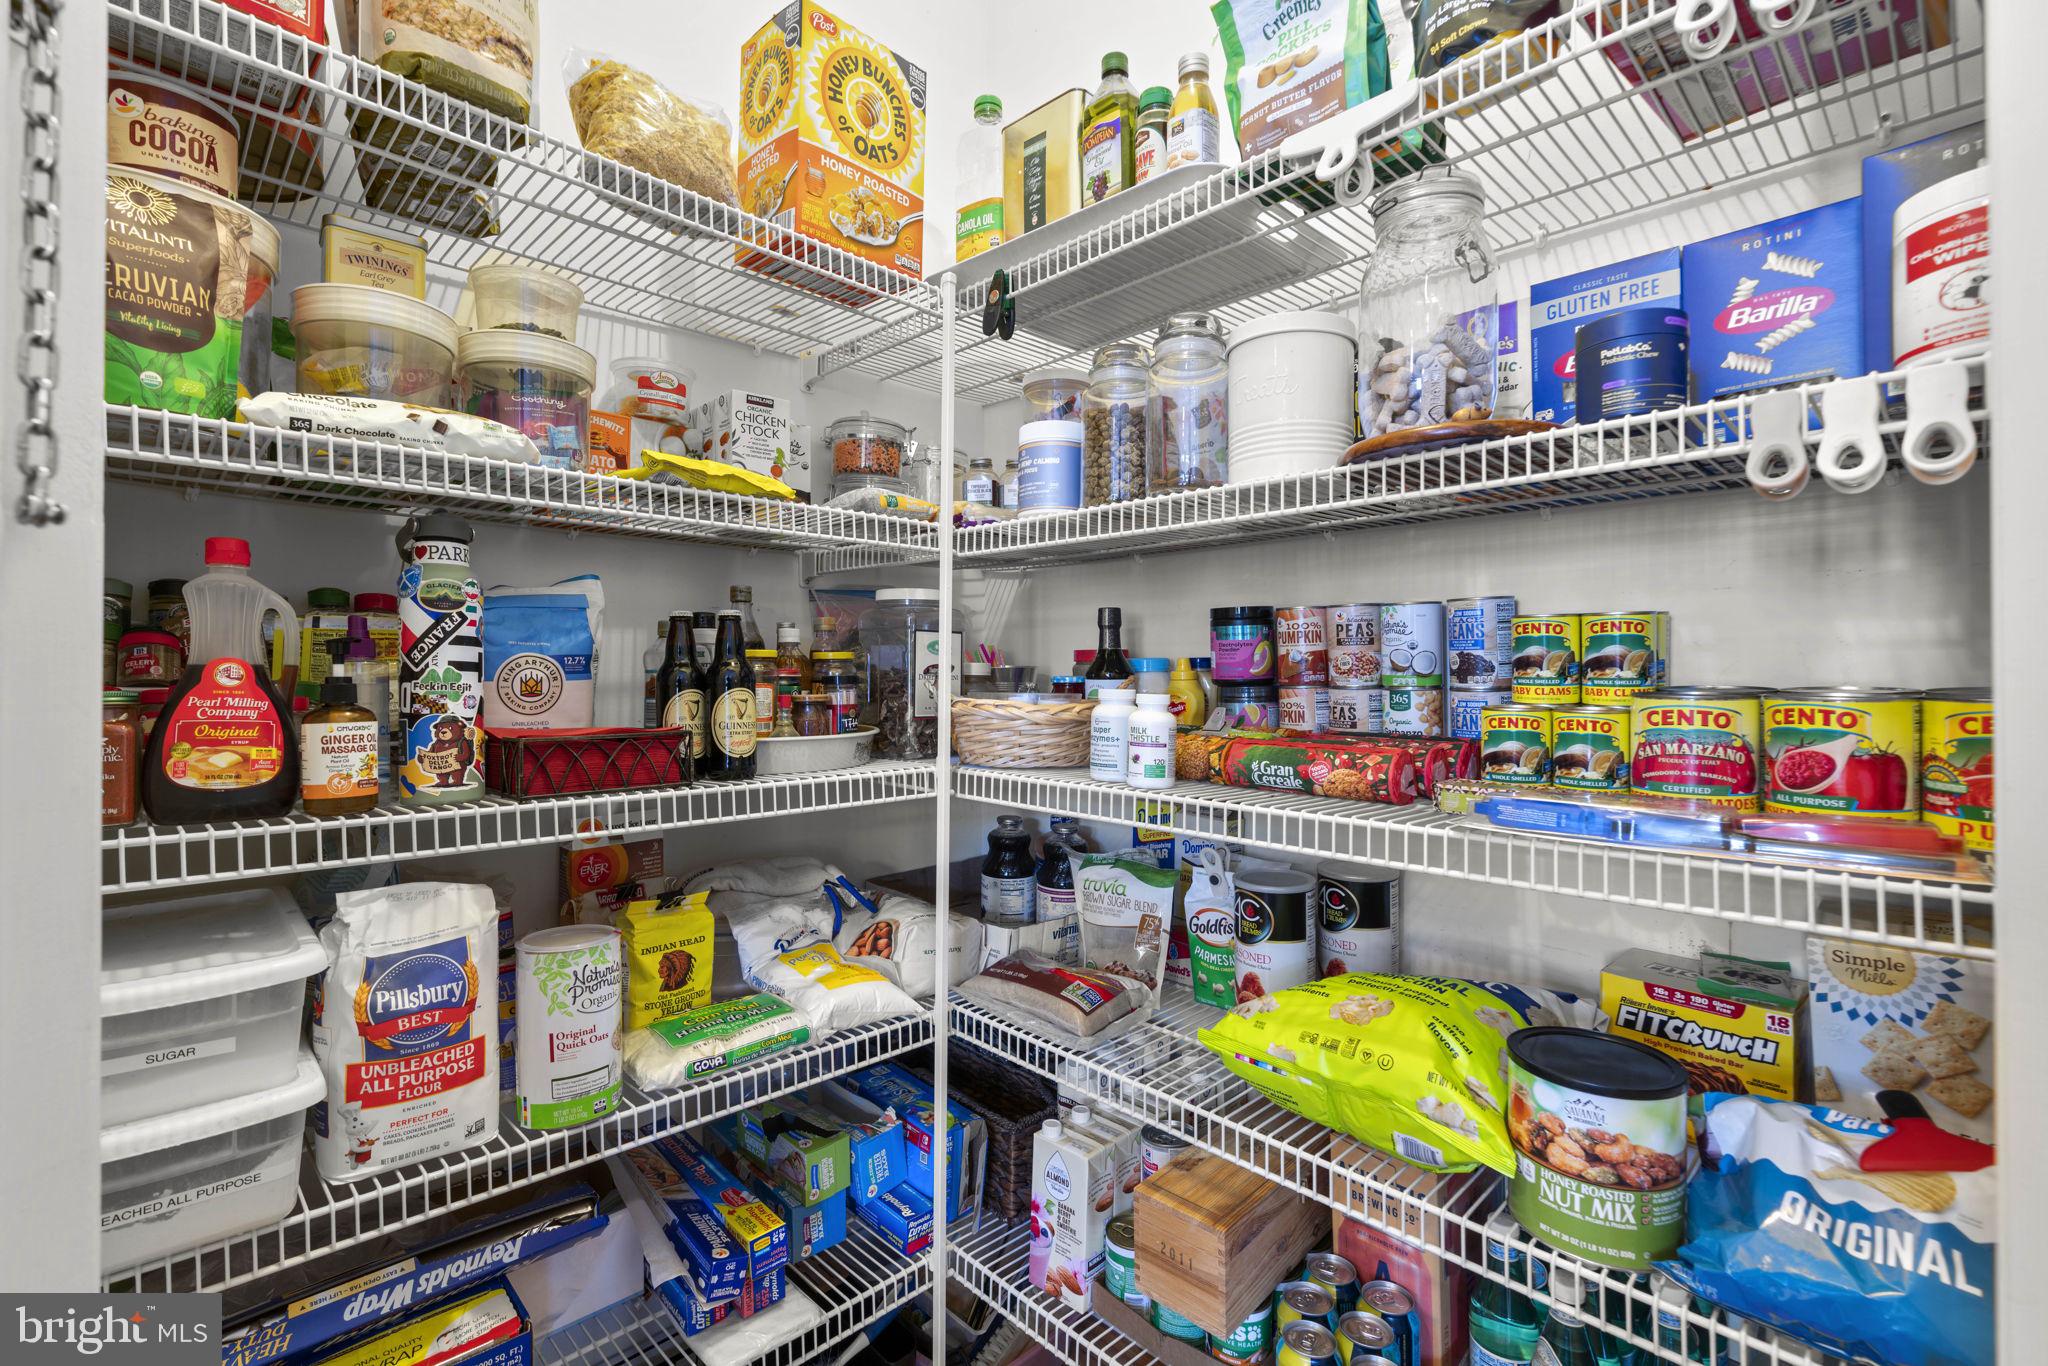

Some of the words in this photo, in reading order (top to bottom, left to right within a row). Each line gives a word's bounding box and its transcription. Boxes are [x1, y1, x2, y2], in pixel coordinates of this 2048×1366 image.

[812, 12, 835, 33] Post
[1278, 18, 1312, 47] PILL
[828, 56, 859, 104] HONEY
[862, 57, 907, 142] BUNCHES
[1241, 105, 1269, 129] PEANUT
[1272, 90, 1307, 111] BUTTER
[1309, 69, 1342, 93] FLAVOR
[144, 108, 218, 146] baking
[129, 119, 219, 174] COCOA
[752, 143, 776, 167] HONEY
[854, 134, 899, 164] OATS
[748, 152, 780, 181] ROASTED
[821, 154, 861, 182] HONEY
[864, 174, 910, 207] ROASTED
[958, 214, 982, 235] CANOLA
[983, 212, 995, 225] OIL
[108, 236, 185, 264] Superfoods
[1742, 229, 1802, 252] ROTINI
[345, 252, 410, 278] TWININGS
[359, 269, 376, 281] Earl
[377, 272, 396, 286] Grey
[371, 279, 385, 289] Tea
[1573, 279, 1604, 293] CLASSIC
[1606, 272, 1628, 283] TASTE
[108, 288, 144, 305] CACAO
[147, 296, 192, 317] POWDER
[1547, 290, 1611, 320] GLUTEN
[1620, 278, 1660, 303] FREE
[1727, 294, 1819, 330] Barilla
[120, 310, 154, 332] Vitality
[156, 320, 182, 338] Living
[735, 410, 786, 428] CHICKEN
[747, 406, 773, 415] ORGANIC
[740, 424, 780, 440] STOCK
[411, 611, 462, 663] FRANCE
[1278, 630, 1322, 644] PUMPKIN
[1286, 622, 1322, 631] 100%
[1336, 622, 1374, 638] PEAS
[1514, 622, 1564, 636] CENTO
[1590, 622, 1646, 634] CENTO
[125, 658, 155, 668] CELERY
[564, 656, 586, 665] 12.7%
[502, 663, 522, 683] KING
[524, 660, 559, 683] ARTHUR
[413, 682, 448, 691] Feckin
[450, 682, 472, 694] Eejit
[1584, 688, 1609, 697] BABY
[188, 696, 221, 708] Pearl
[224, 696, 269, 711] Milling
[504, 692, 527, 710] BAKING
[530, 691, 556, 711] COMPANY
[1390, 694, 1409, 704] 365
[196, 708, 259, 720] Company
[1389, 718, 1412, 726] Organic
[1488, 717, 1541, 731] CENTO
[1646, 710, 1732, 729] CENTO
[1772, 707, 1859, 729] CENTO
[194, 724, 260, 740] Original
[1094, 726, 1111, 735] super
[1130, 726, 1147, 734] MILK
[1558, 719, 1613, 733] CENTO
[1130, 734, 1160, 743] THISTLE
[1638, 744, 1661, 760] SAN
[1665, 743, 1746, 765] MARZANO
[1260, 760, 1294, 777] Gran
[1254, 772, 1303, 788] Cereale
[1662, 784, 1712, 795] CERTIFIED
[1776, 794, 1791, 804] ALL
[1794, 794, 1847, 808] PURPOSE
[1143, 832, 1171, 840] SUPERFINE
[1083, 890, 1105, 905] BROWN
[1108, 895, 1132, 910] SUGAR
[1134, 900, 1158, 914] BLEND
[1144, 916, 1160, 929] 75%
[640, 943, 678, 957] INDIAN
[680, 935, 706, 948] HEAD
[1832, 949, 1907, 975] Simple
[572, 959, 621, 987] Nature's
[1846, 966, 1897, 987] Mills
[375, 980, 464, 1014] Pillsbury
[644, 1000, 674, 1011] STONE
[674, 990, 706, 1005] GROUND
[658, 992, 668, 1000] Old
[669, 986, 695, 999] Fashioned
[1348, 979, 1397, 993] perfectly
[1400, 990, 1436, 1007] salted
[661, 1000, 694, 1017] YELLOW
[683, 1010, 723, 1027] Corn
[724, 1002, 760, 1016] Meal
[1620, 996, 1647, 1009] ROBERT
[1648, 1002, 1676, 1016] IRVINE'S
[398, 1010, 443, 1031] BEST
[675, 1020, 725, 1040] Harina
[728, 1013, 745, 1023] de
[747, 1004, 780, 1018] Maiz
[1452, 1024, 1466, 1037] no
[1768, 1015, 1791, 1029] 18
[1768, 1026, 1791, 1035] BARS
[556, 1024, 597, 1042] Original
[556, 1036, 587, 1053] Quick
[589, 1032, 610, 1044] Oats
[1428, 1022, 1460, 1060] flavors
[1432, 1016, 1473, 1056] artificial
[1617, 1006, 1779, 1065] FITCRUNCH
[145, 1046, 197, 1066] SUGAR
[360, 1042, 475, 1080] UNBLEACHED
[693, 1057, 725, 1072] GOYA
[1644, 1038, 1662, 1049] High
[1664, 1041, 1696, 1058] Protein
[1698, 1050, 1726, 1066] Baked
[1728, 1060, 1745, 1070] Bar
[360, 1078, 394, 1095] ALL
[398, 1056, 475, 1089] PURPOSE
[398, 1081, 443, 1101] FLOUR
[402, 1100, 437, 1113] ENRICHED
[1564, 1104, 1606, 1125] SAVANNA
[390, 1114, 429, 1129] PERFECT
[431, 1108, 449, 1119] FOR
[1046, 1170, 1070, 1188] ALMOND
[1540, 1168, 1581, 1191] HONEY
[1581, 1184, 1635, 1203] ROASTED
[167, 1196, 192, 1210] ALL
[196, 1172, 263, 1202] PURPOSE
[1058, 1201, 1076, 1217] BANANA
[1351, 1190, 1399, 1219] BREWING
[1540, 1179, 1585, 1213] NUT
[1592, 1198, 1637, 1225] MIX
[754, 1204, 768, 1215] Stay
[765, 1213, 780, 1228] FLAT
[1058, 1208, 1071, 1219] BERRY
[702, 1212, 731, 1243] PAPER
[772, 1232, 786, 1244] 45
[1056, 1221, 1077, 1238] SMOOTHIE
[1780, 1190, 1984, 1299] ORIGINAL
[416, 1238, 524, 1295] Reynolds
[1160, 1242, 1193, 1272] 2011
[344, 1280, 413, 1323] Wrap
[455, 1330, 473, 1342] MORE
[474, 1314, 501, 1335] STRETCH
[384, 1336, 425, 1357] QUALITY
[1238, 1339, 1262, 1349] HEALTH
